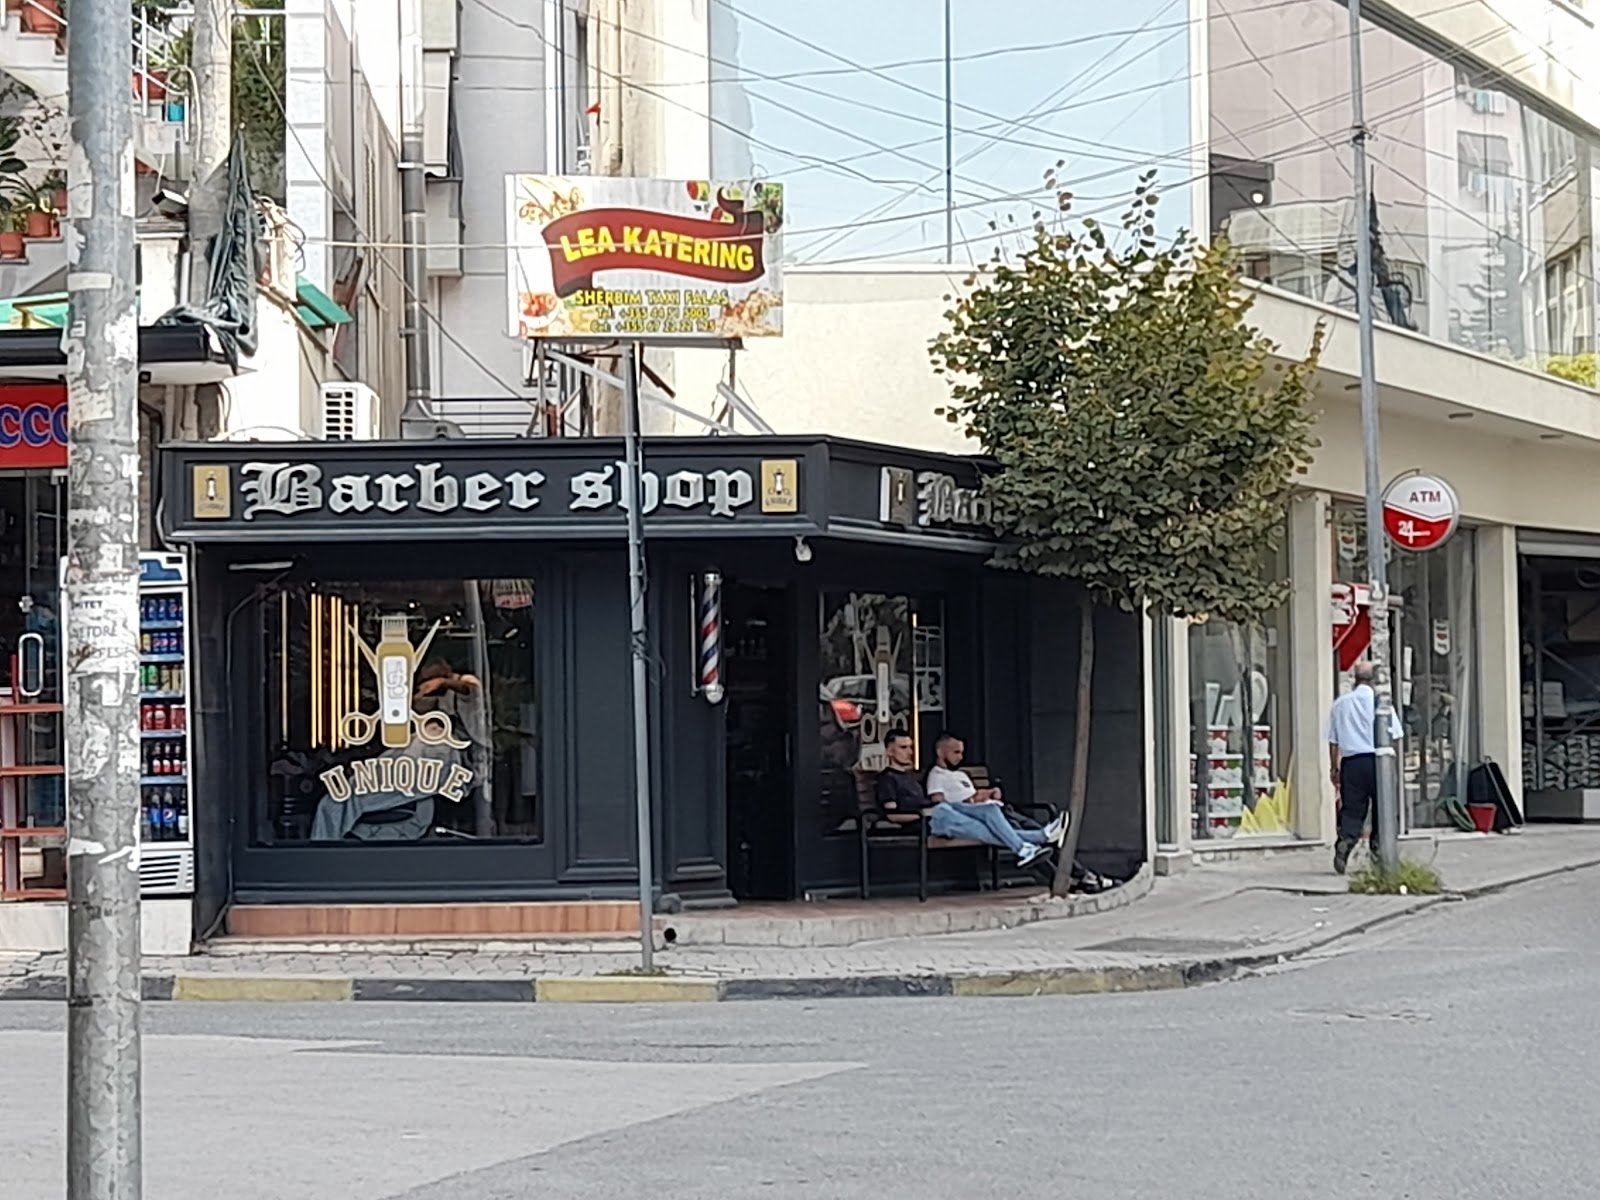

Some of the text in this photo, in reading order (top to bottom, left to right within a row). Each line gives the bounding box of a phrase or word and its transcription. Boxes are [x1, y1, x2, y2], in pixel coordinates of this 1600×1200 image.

[560, 226, 755, 271] LEA KATERING
[575, 289, 729, 305] SHERBIM TAXI FALAS
[240, 460, 753, 520] Barber shop
[1409, 491, 1441, 502] ATM
[320, 757, 473, 802] UNIQUE
